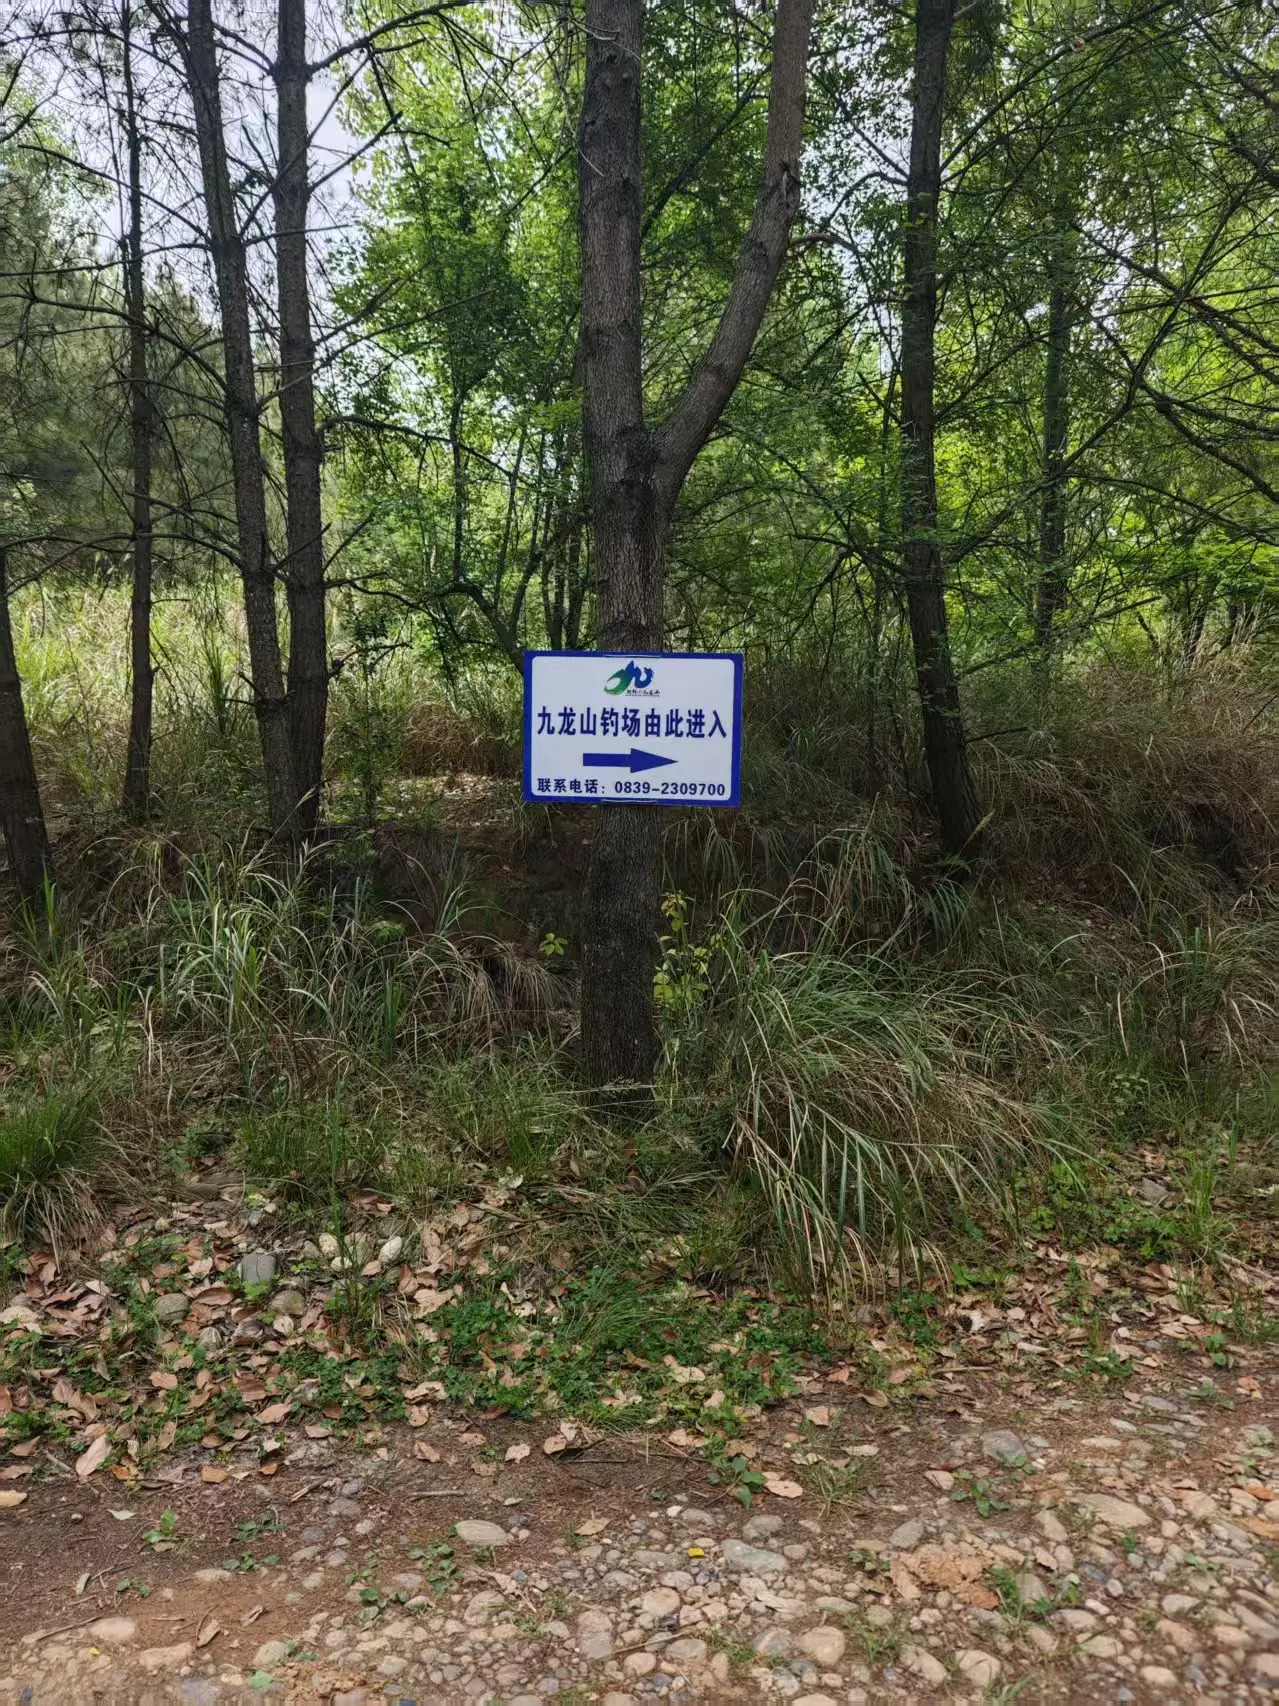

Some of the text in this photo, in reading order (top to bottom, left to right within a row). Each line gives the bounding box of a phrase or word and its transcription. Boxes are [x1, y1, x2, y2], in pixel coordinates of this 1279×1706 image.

[537, 706, 727, 738] 九龙山钓场由此进入
